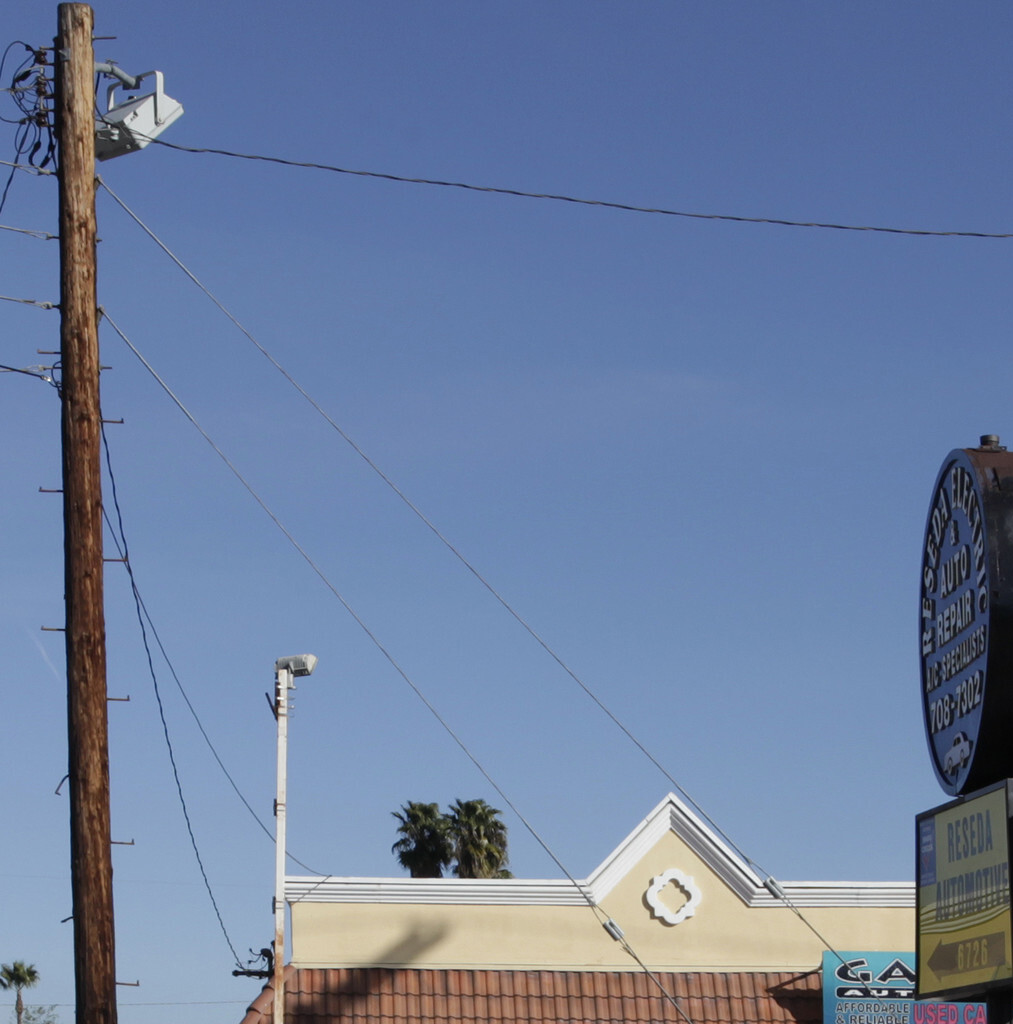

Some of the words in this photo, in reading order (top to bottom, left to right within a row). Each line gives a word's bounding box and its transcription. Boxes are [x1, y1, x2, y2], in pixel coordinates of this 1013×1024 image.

[950, 519, 959, 546] &
[922, 487, 949, 656] RESEDA
[951, 466, 987, 612] ELECTRIC
[941, 544, 970, 598] AUTO
[937, 589, 974, 648] REPAIR
[926, 661, 941, 692] A/C
[941, 624, 986, 681] SPECIALISTS
[930, 670, 983, 734] 708-7302
[947, 809, 993, 863] RESEDA
[936, 862, 1010, 921] AUTOMOTIVE
[957, 938, 988, 970] 6726
[836, 1003, 909, 1013] AFFORDABLE
[837, 1015, 845, 1024] &
[850, 1015, 909, 1024] RELIABLE
[844, 989, 913, 997] AUT
[914, 1004, 958, 1024] USED
